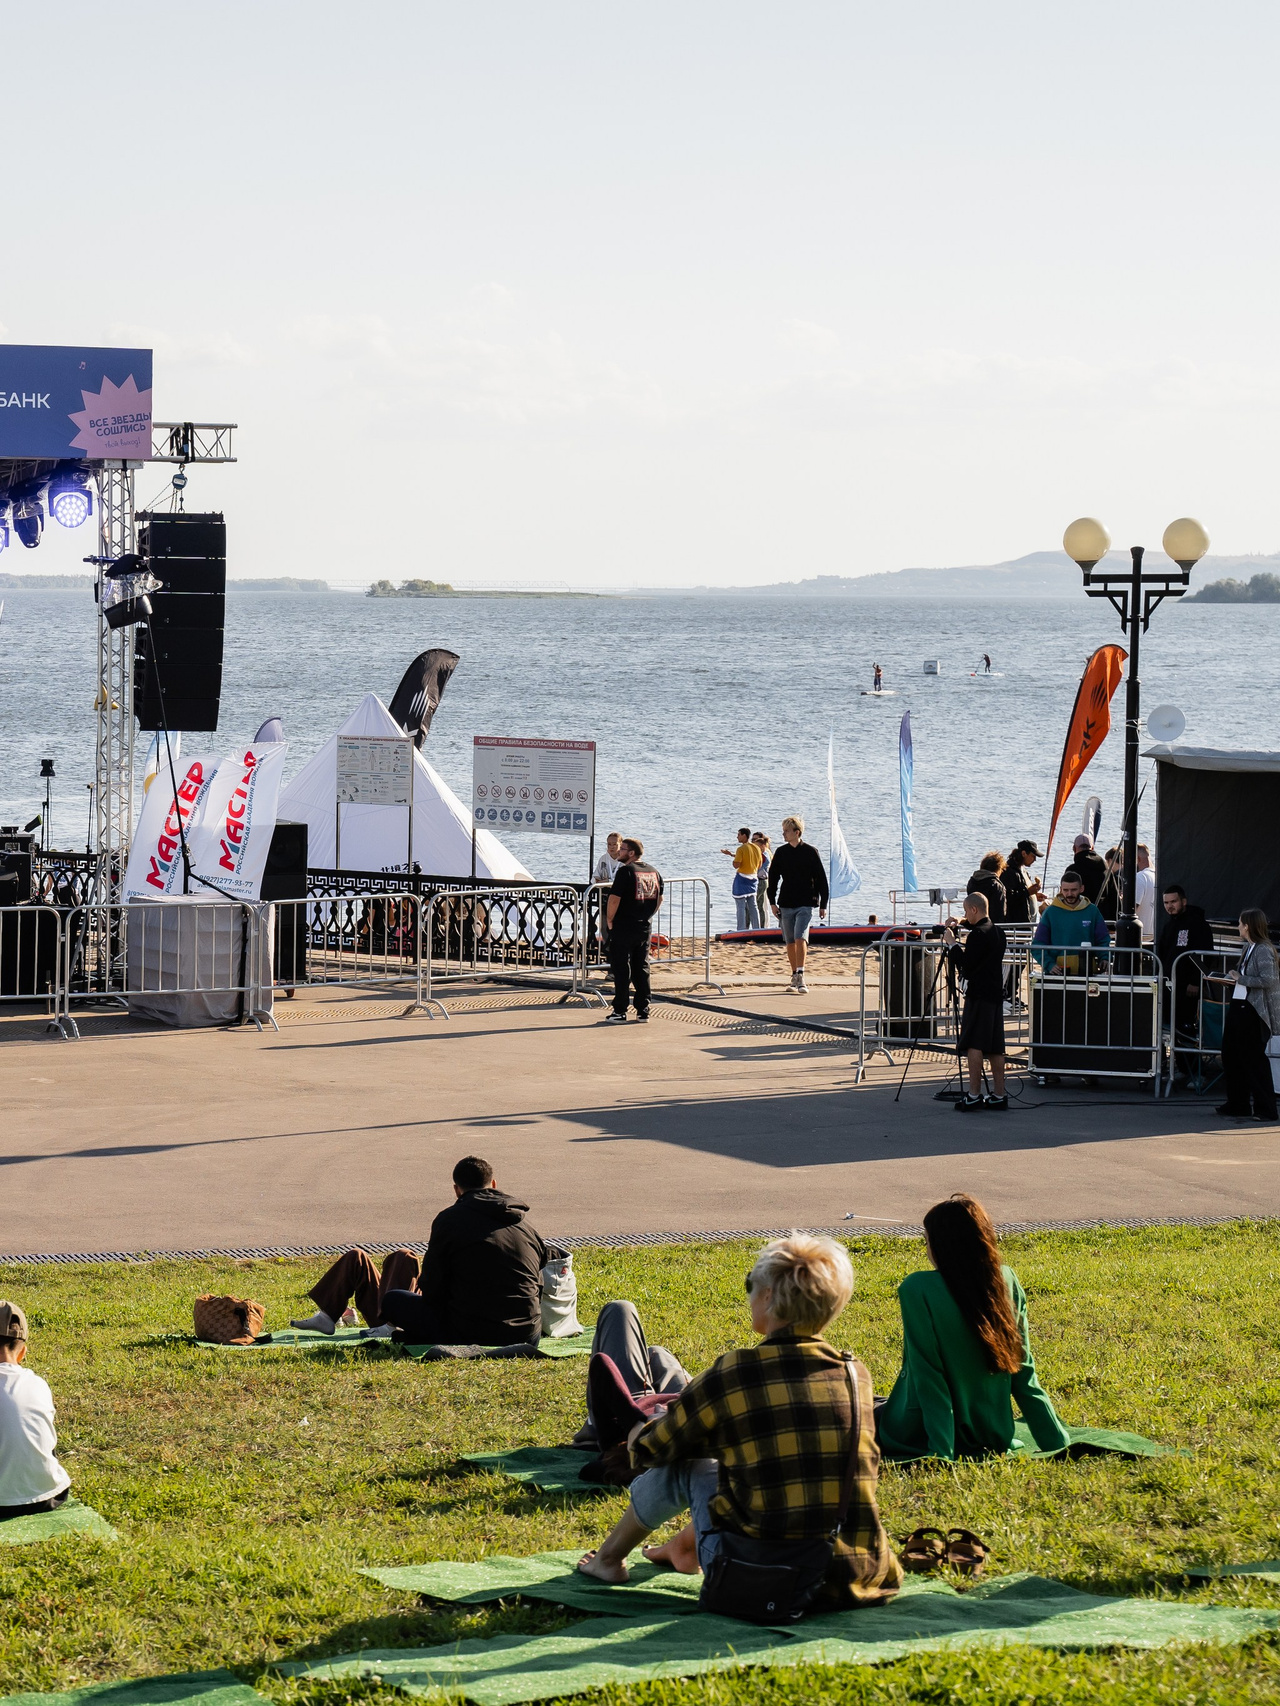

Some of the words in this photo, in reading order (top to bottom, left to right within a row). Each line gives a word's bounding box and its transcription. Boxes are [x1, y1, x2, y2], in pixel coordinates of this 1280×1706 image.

[89, 417, 109, 428] ВСЕ
[111, 411, 151, 426] ЗВЕЗДЫ
[95, 423, 146, 437] СОШЛИСЬ
[145, 761, 205, 890] МАСТЕР
[235, 827, 251, 876] РОССИЙСКАЯ
[246, 787, 255, 826] АКАДЕМИЯ
